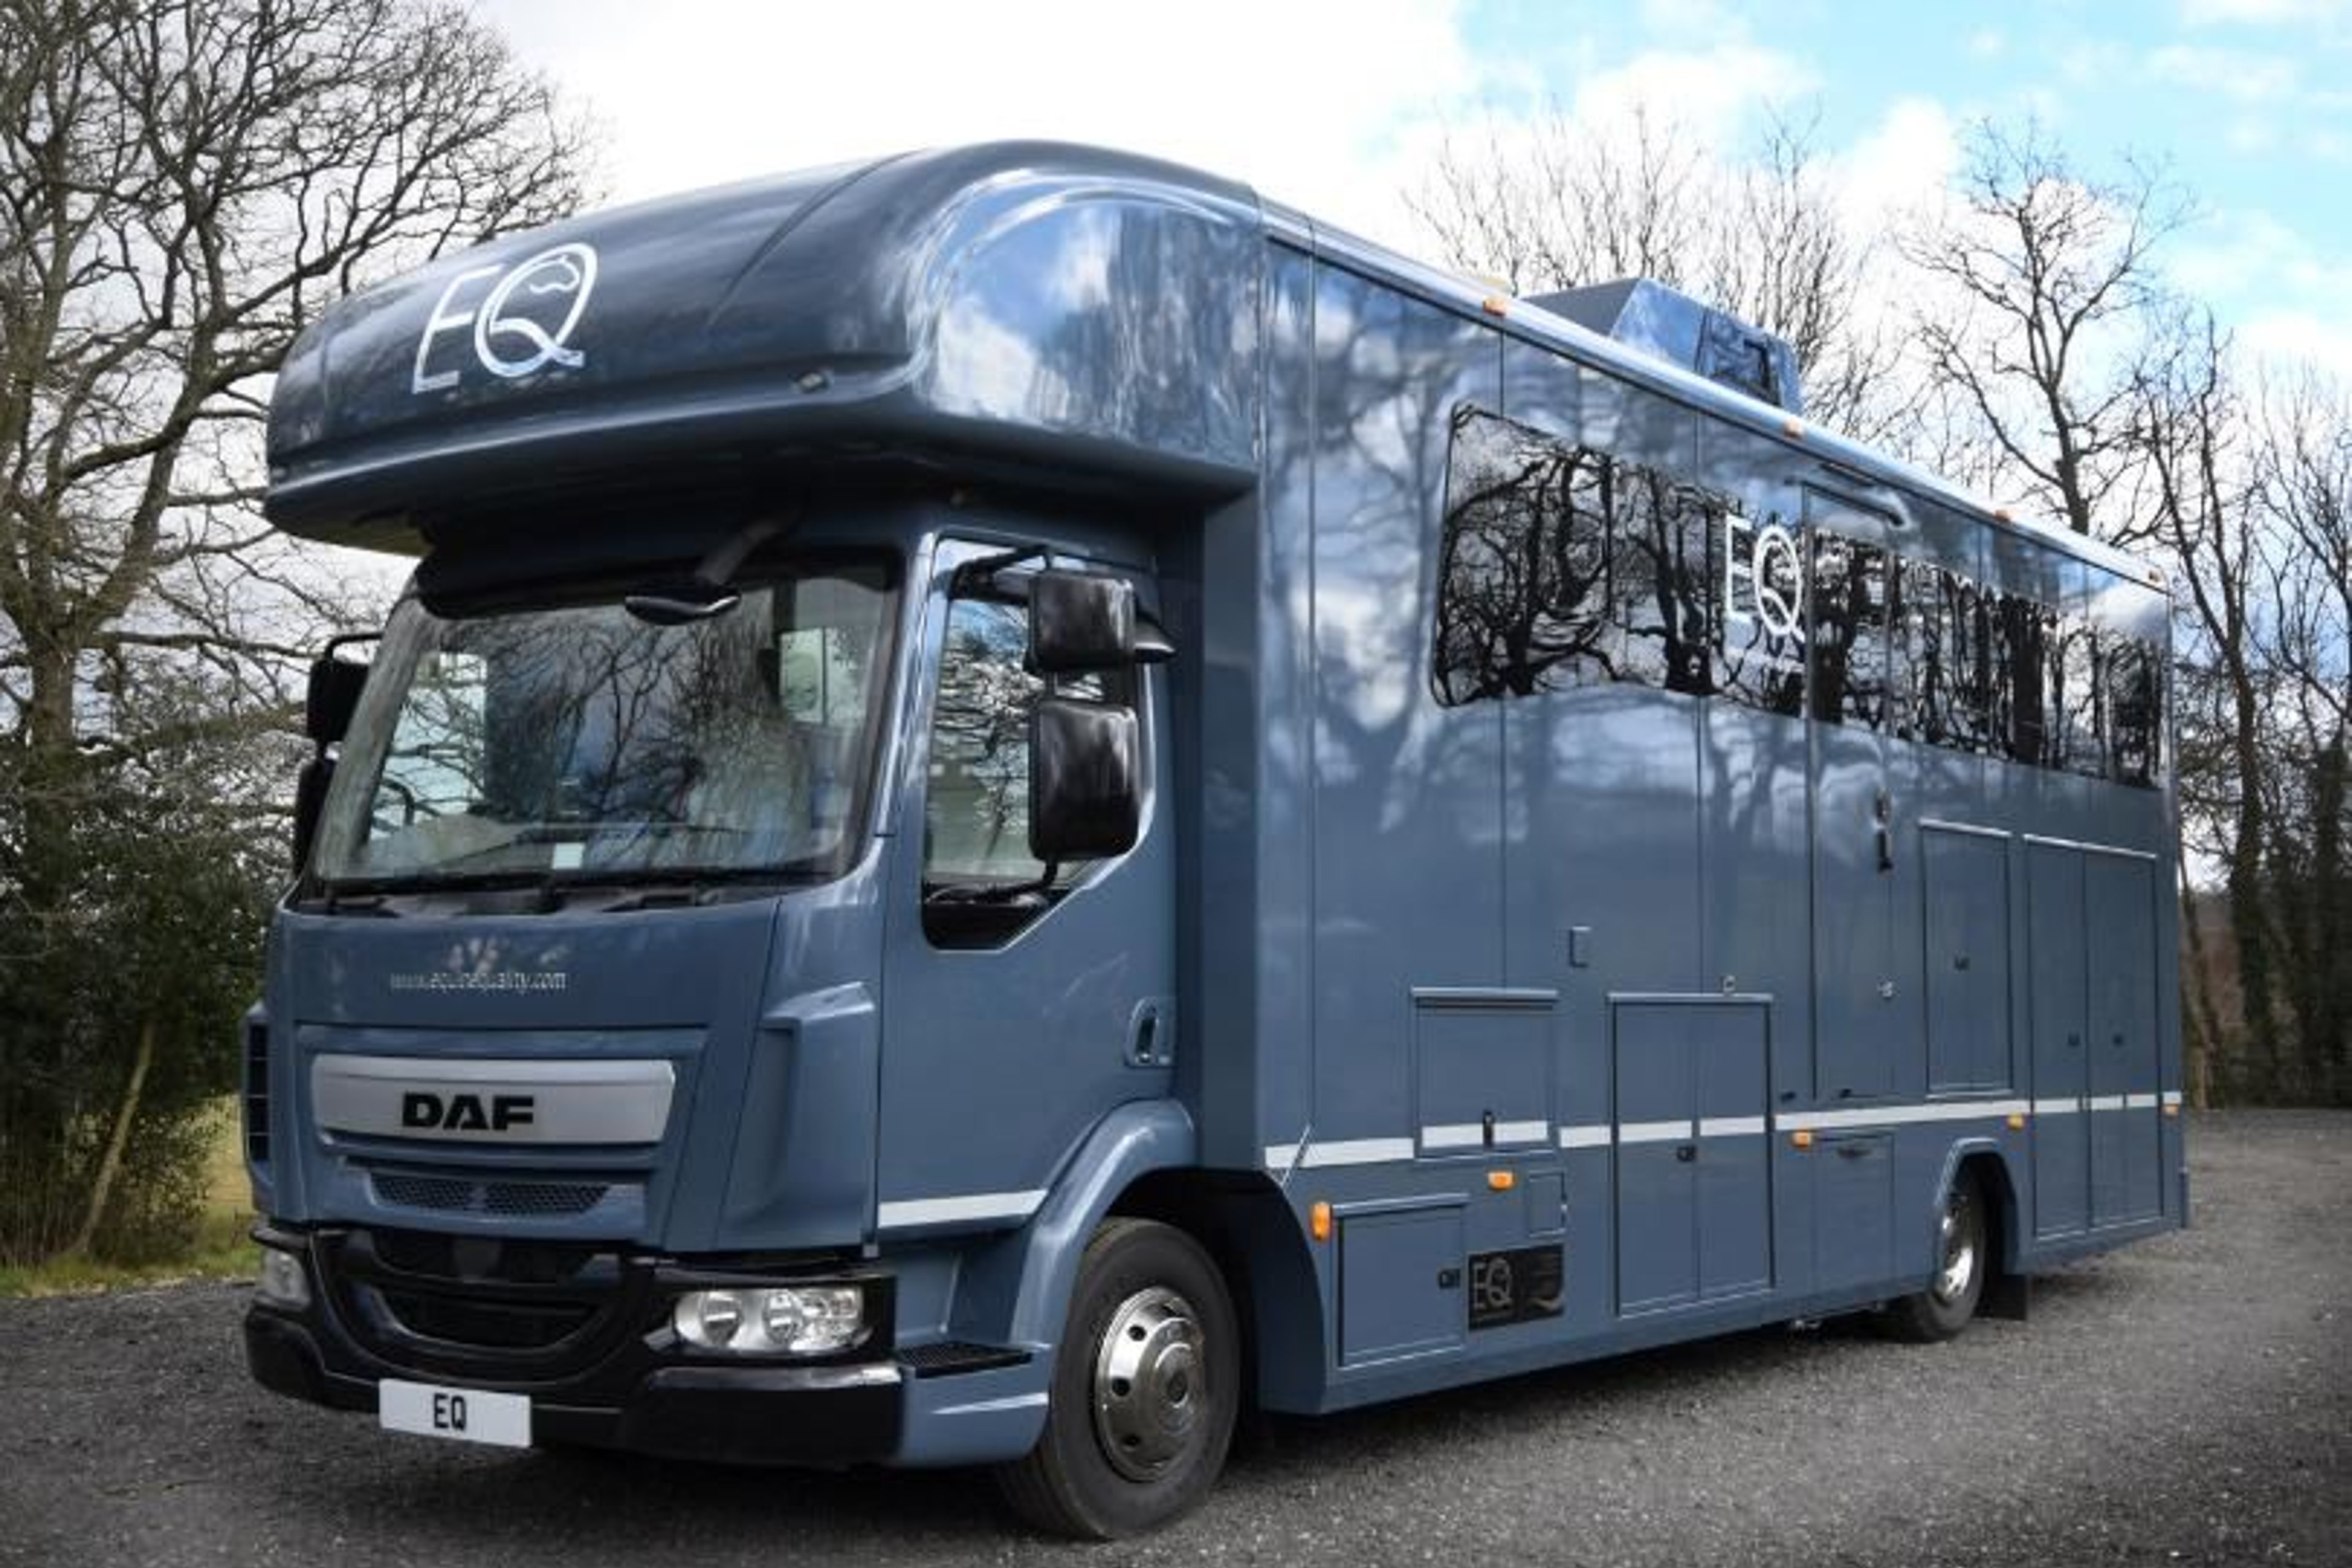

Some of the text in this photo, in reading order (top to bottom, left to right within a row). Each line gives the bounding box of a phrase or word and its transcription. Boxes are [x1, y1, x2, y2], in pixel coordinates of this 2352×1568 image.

[412, 243, 597, 394] EQ
[1725, 513, 1806, 643] EQ
[402, 1092, 534, 1130] DAF
[1473, 1257, 1513, 1310] EQ
[434, 1392, 467, 1430] EQ
